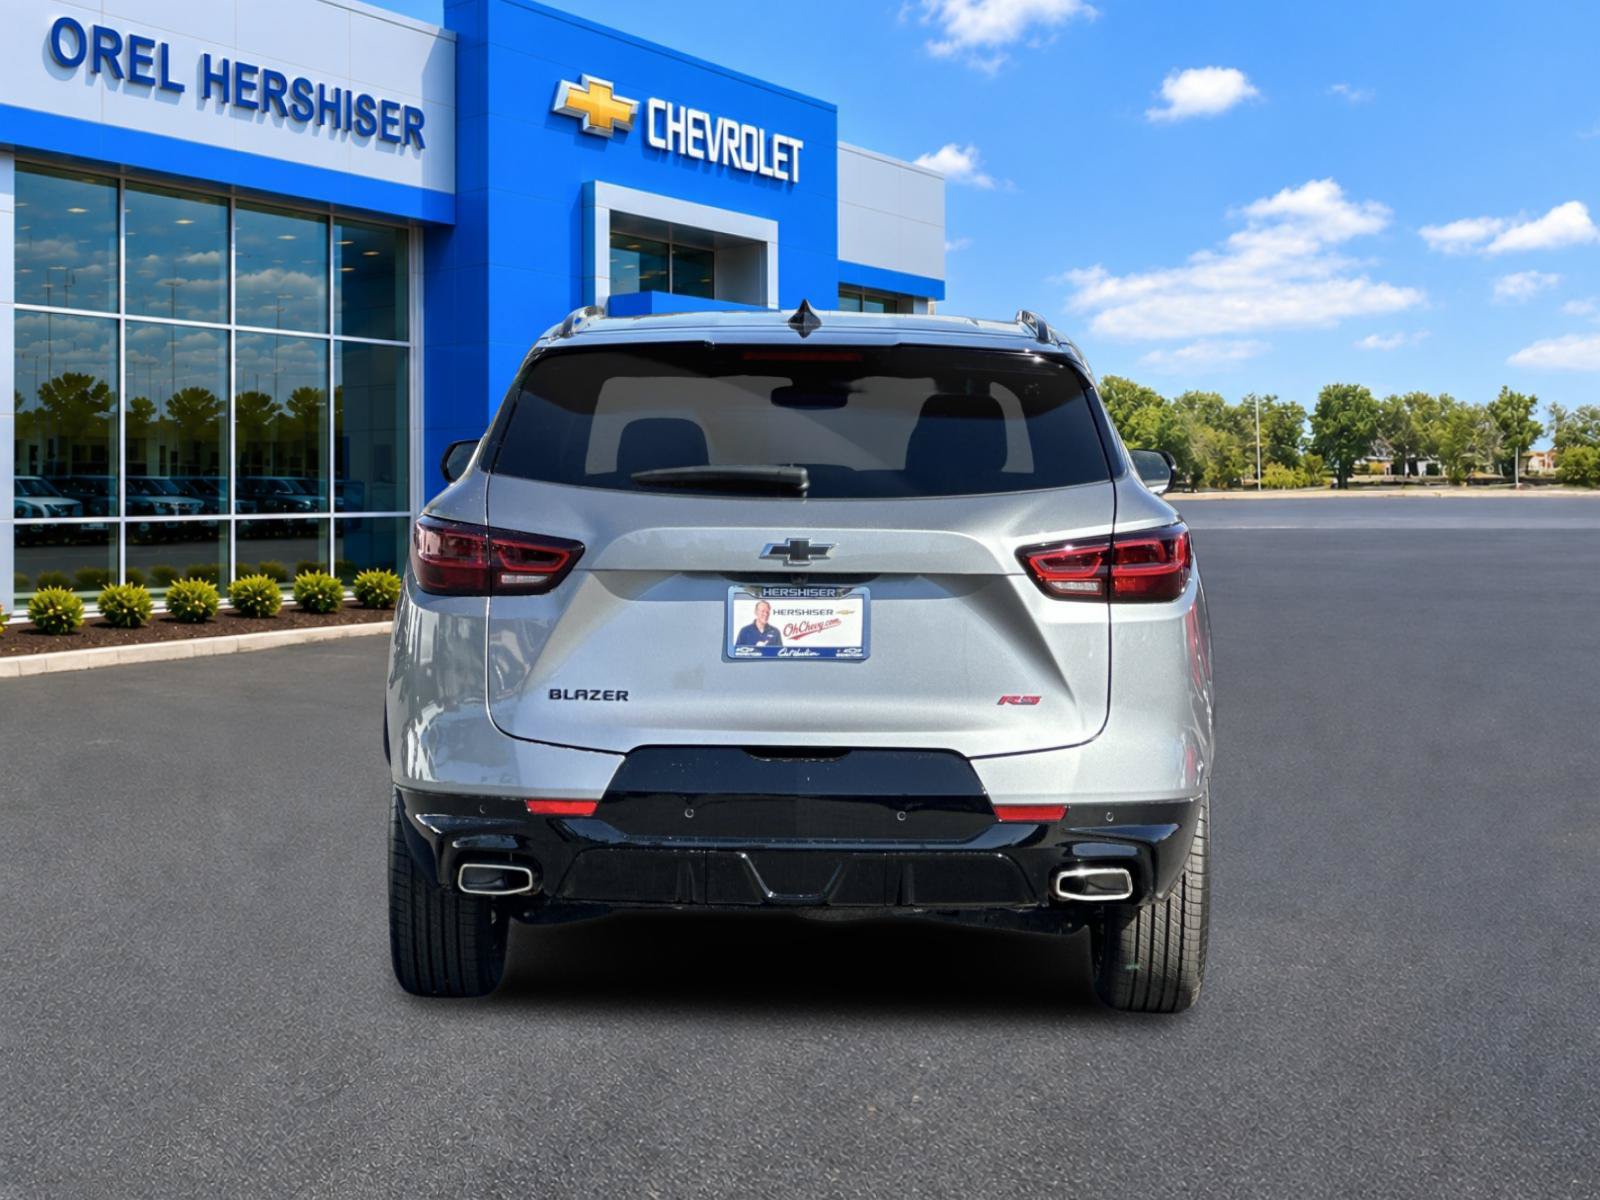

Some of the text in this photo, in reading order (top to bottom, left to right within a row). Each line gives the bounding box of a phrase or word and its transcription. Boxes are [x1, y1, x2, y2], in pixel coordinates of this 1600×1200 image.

[50, 16, 426, 150] OREL HERSHISER
[648, 97, 804, 183] CHEVROLET
[763, 588, 836, 597] HERSHISER
[773, 608, 834, 616] HERSHISER
[549, 688, 629, 701] BLAZER
[997, 695, 1042, 705] RS
